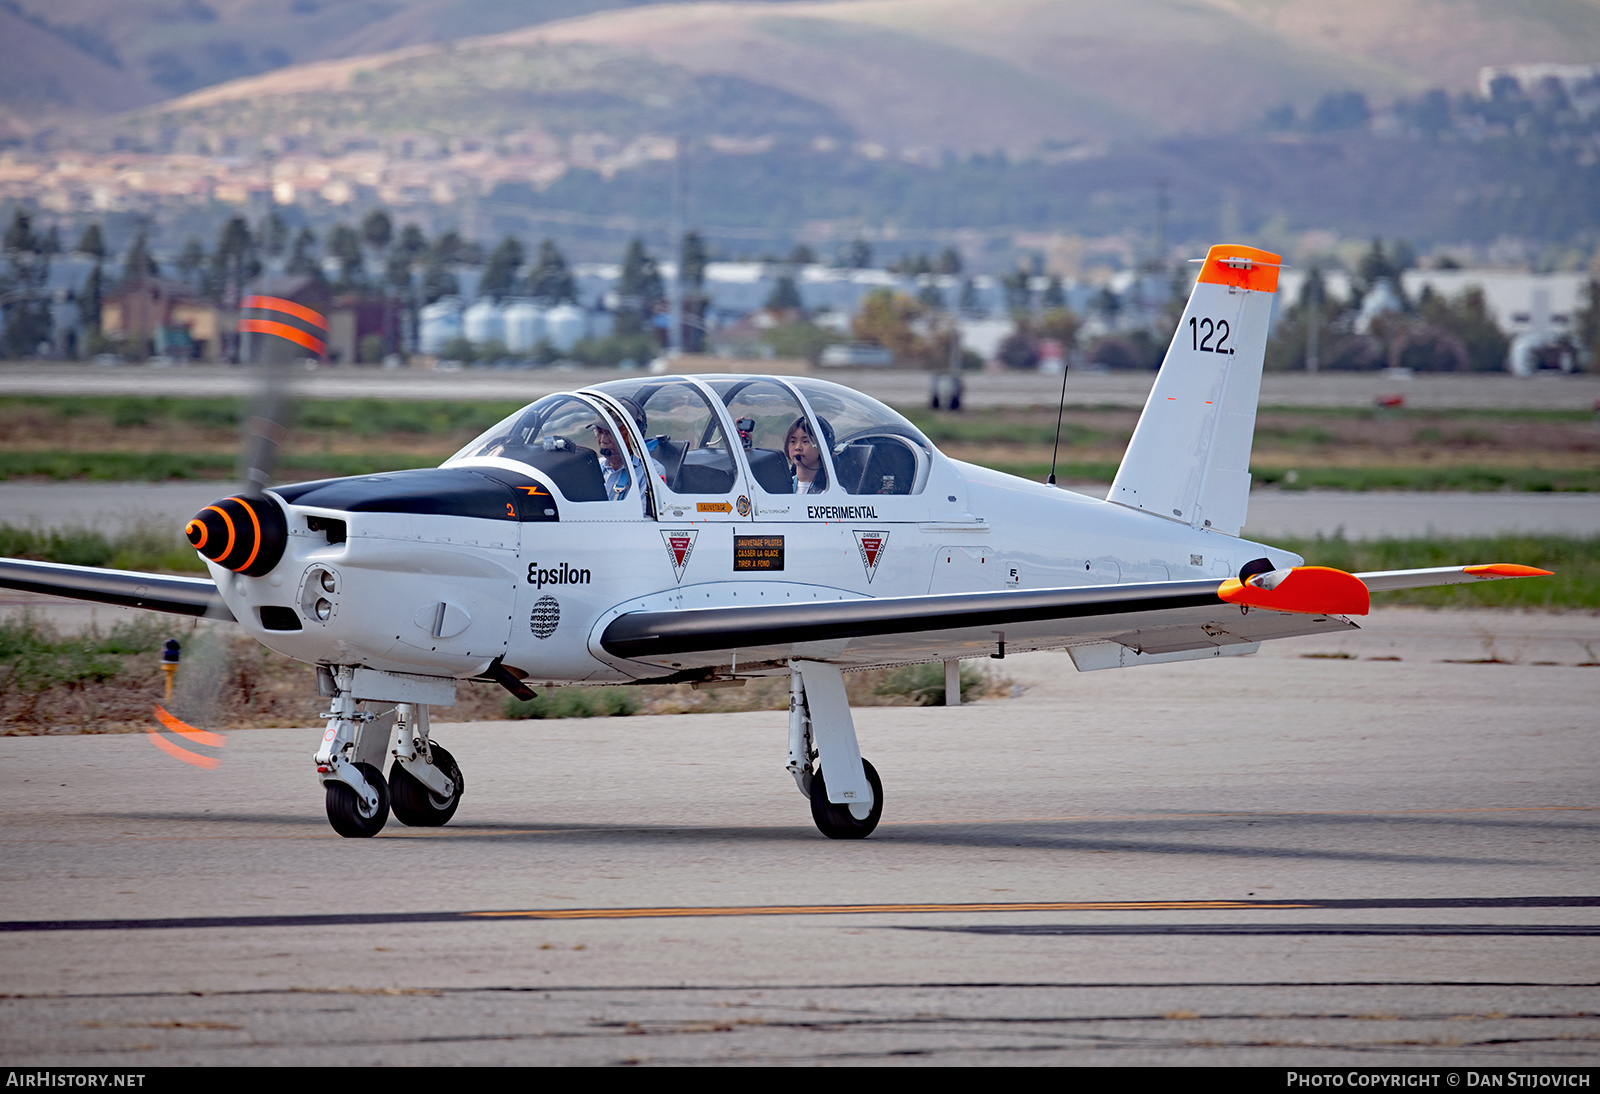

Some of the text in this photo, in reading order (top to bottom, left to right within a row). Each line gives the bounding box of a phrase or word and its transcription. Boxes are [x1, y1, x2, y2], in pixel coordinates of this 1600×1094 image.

[807, 505, 879, 519] EXPERIMENTAL
[764, 538, 782, 547] PILOTES
[756, 549, 763, 557] LA
[764, 549, 779, 557] GLACE
[526, 562, 591, 590] Epsilon
